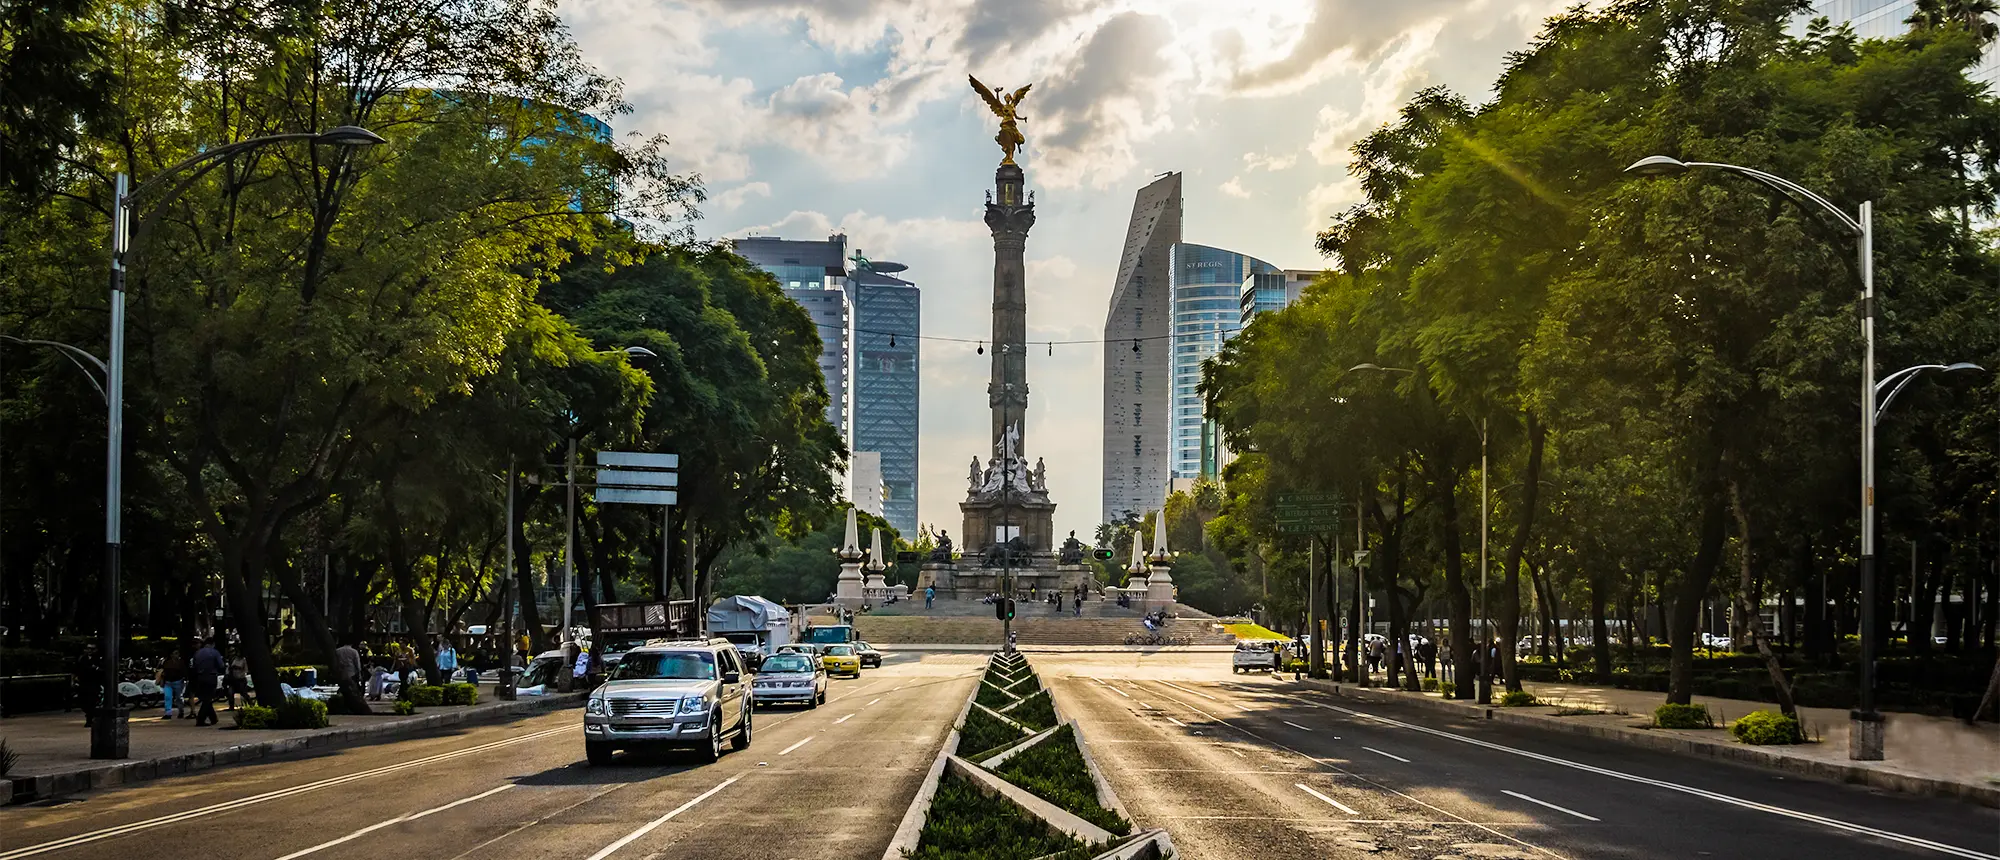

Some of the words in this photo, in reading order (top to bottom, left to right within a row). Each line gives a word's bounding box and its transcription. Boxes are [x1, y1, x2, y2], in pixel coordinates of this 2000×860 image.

[1295, 494, 1325, 502] INTERIOR
[1326, 493, 1338, 501] SUR
[1285, 509, 1309, 517] INTERIOR
[1311, 508, 1329, 517] NORTE
[1308, 523, 1340, 532] PONIENTE
